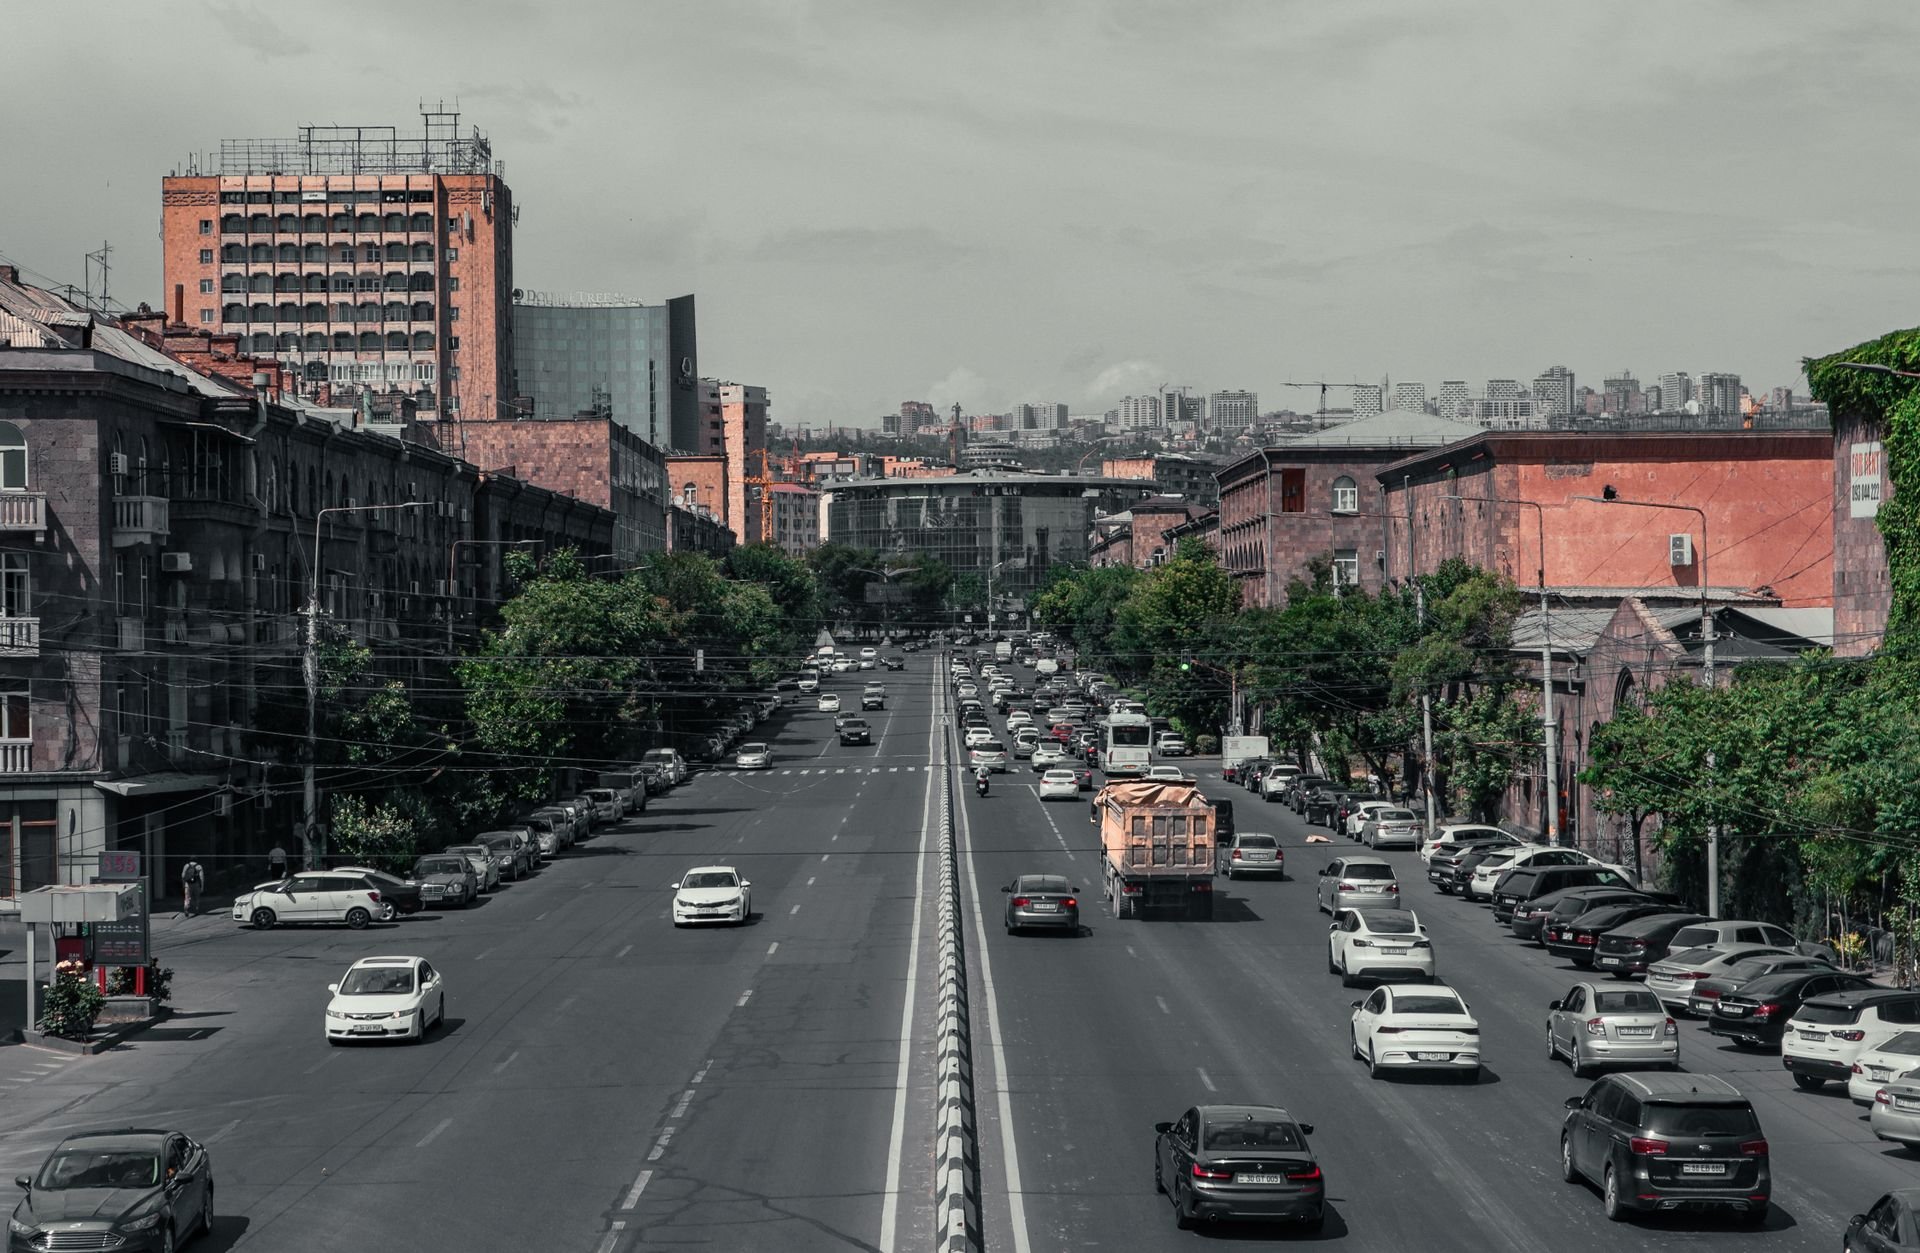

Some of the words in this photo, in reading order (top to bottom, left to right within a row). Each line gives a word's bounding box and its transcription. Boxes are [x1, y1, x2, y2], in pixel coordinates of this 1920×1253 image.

[526, 289, 612, 304] DOUTREE
[1852, 452, 1863, 476] FOR
[1864, 451, 1880, 476] RENT
[1852, 484, 1861, 501] 093
[1862, 484, 1870, 501] 044
[1871, 483, 1880, 500] 222
